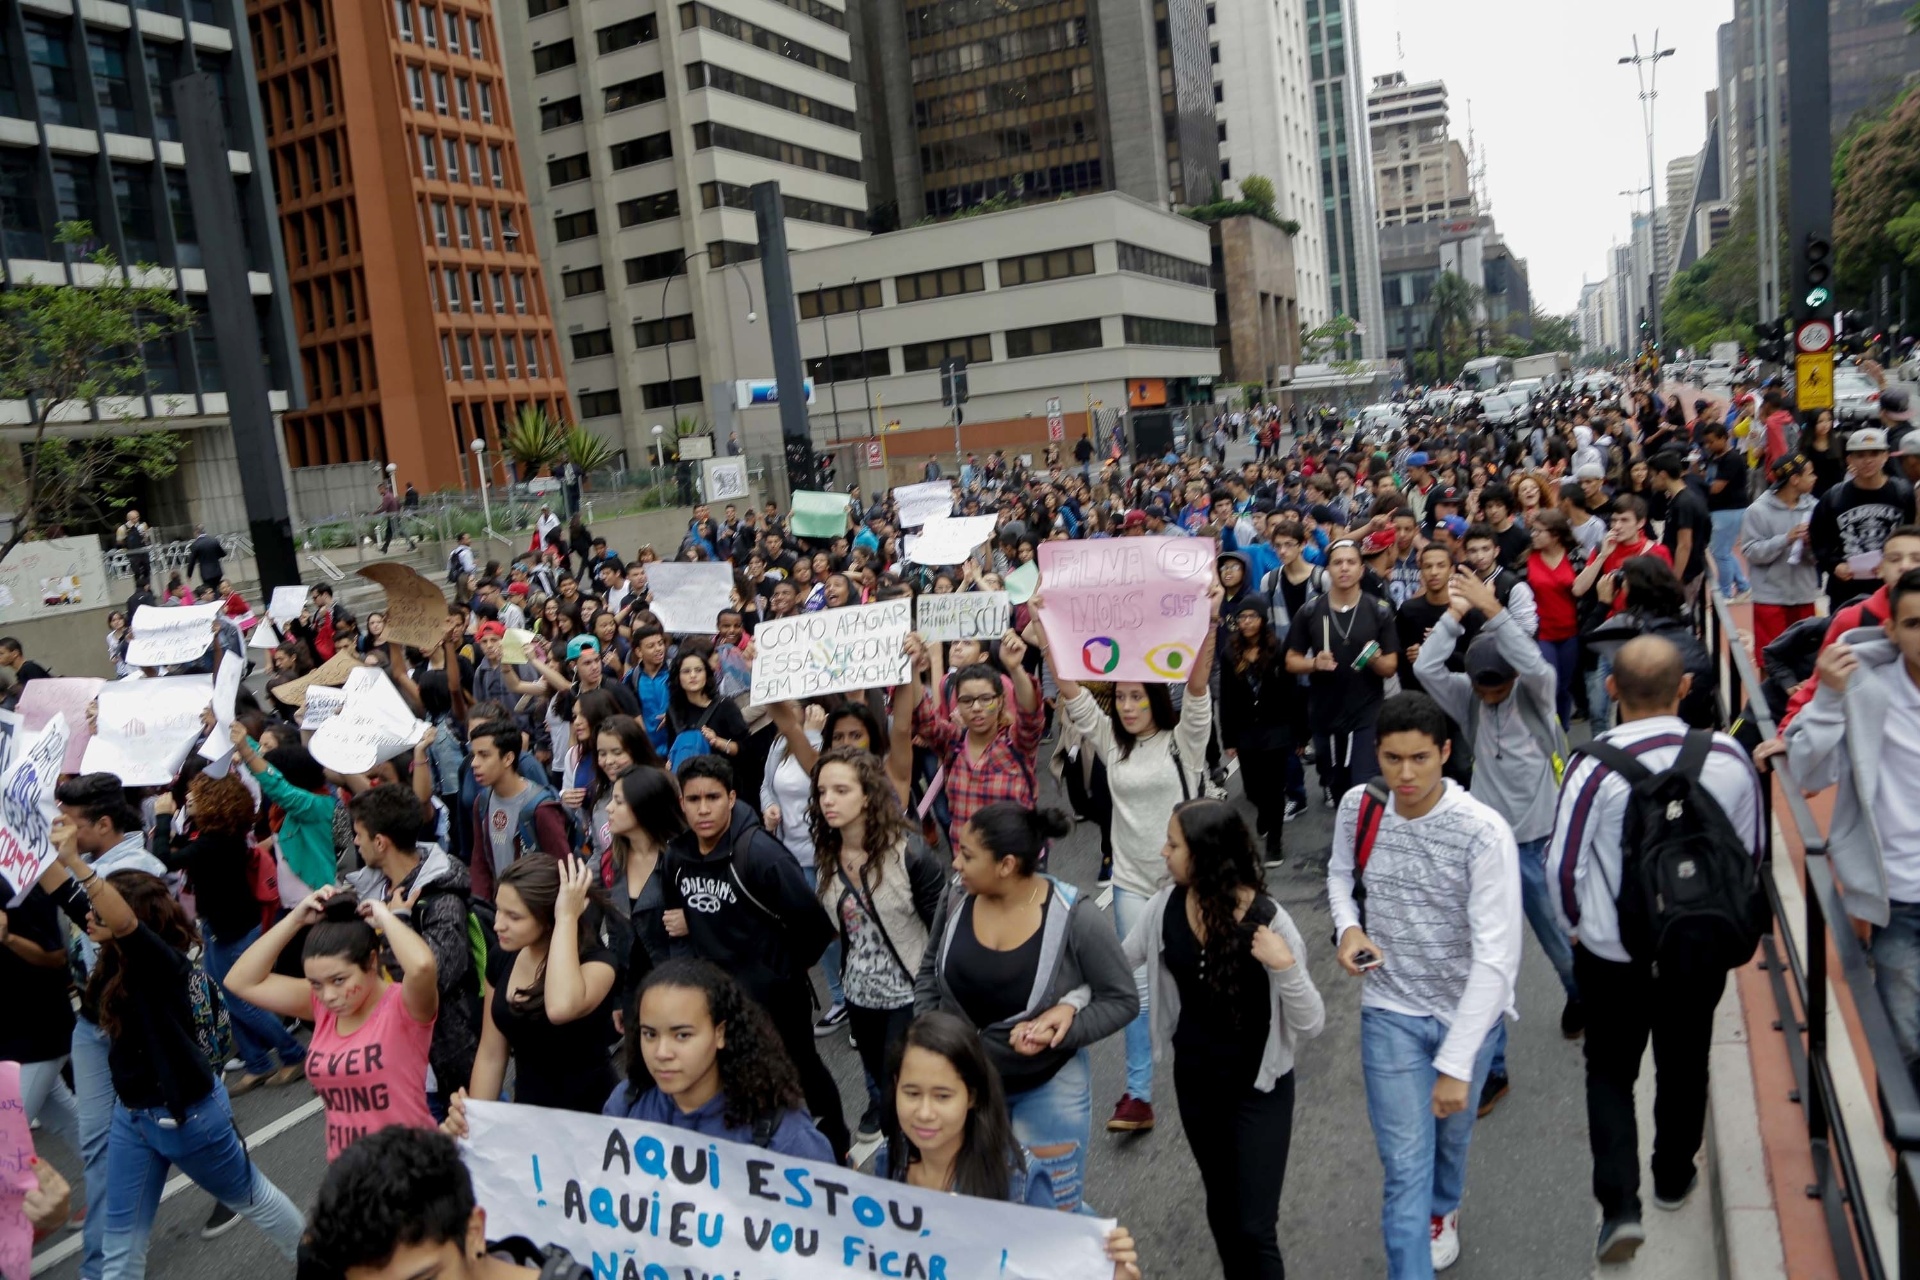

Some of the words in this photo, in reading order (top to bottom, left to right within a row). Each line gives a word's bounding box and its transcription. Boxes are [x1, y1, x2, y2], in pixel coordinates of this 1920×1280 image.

[760, 617, 826, 649] COMO
[835, 603, 906, 637] APAGAR
[920, 612, 956, 629] MINHA
[959, 604, 1009, 638] ESCOLA
[760, 650, 815, 677] ESSA
[754, 675, 792, 700] SEM
[305, 1044, 384, 1077] EVER
[743, 1217, 819, 1257] VOU
